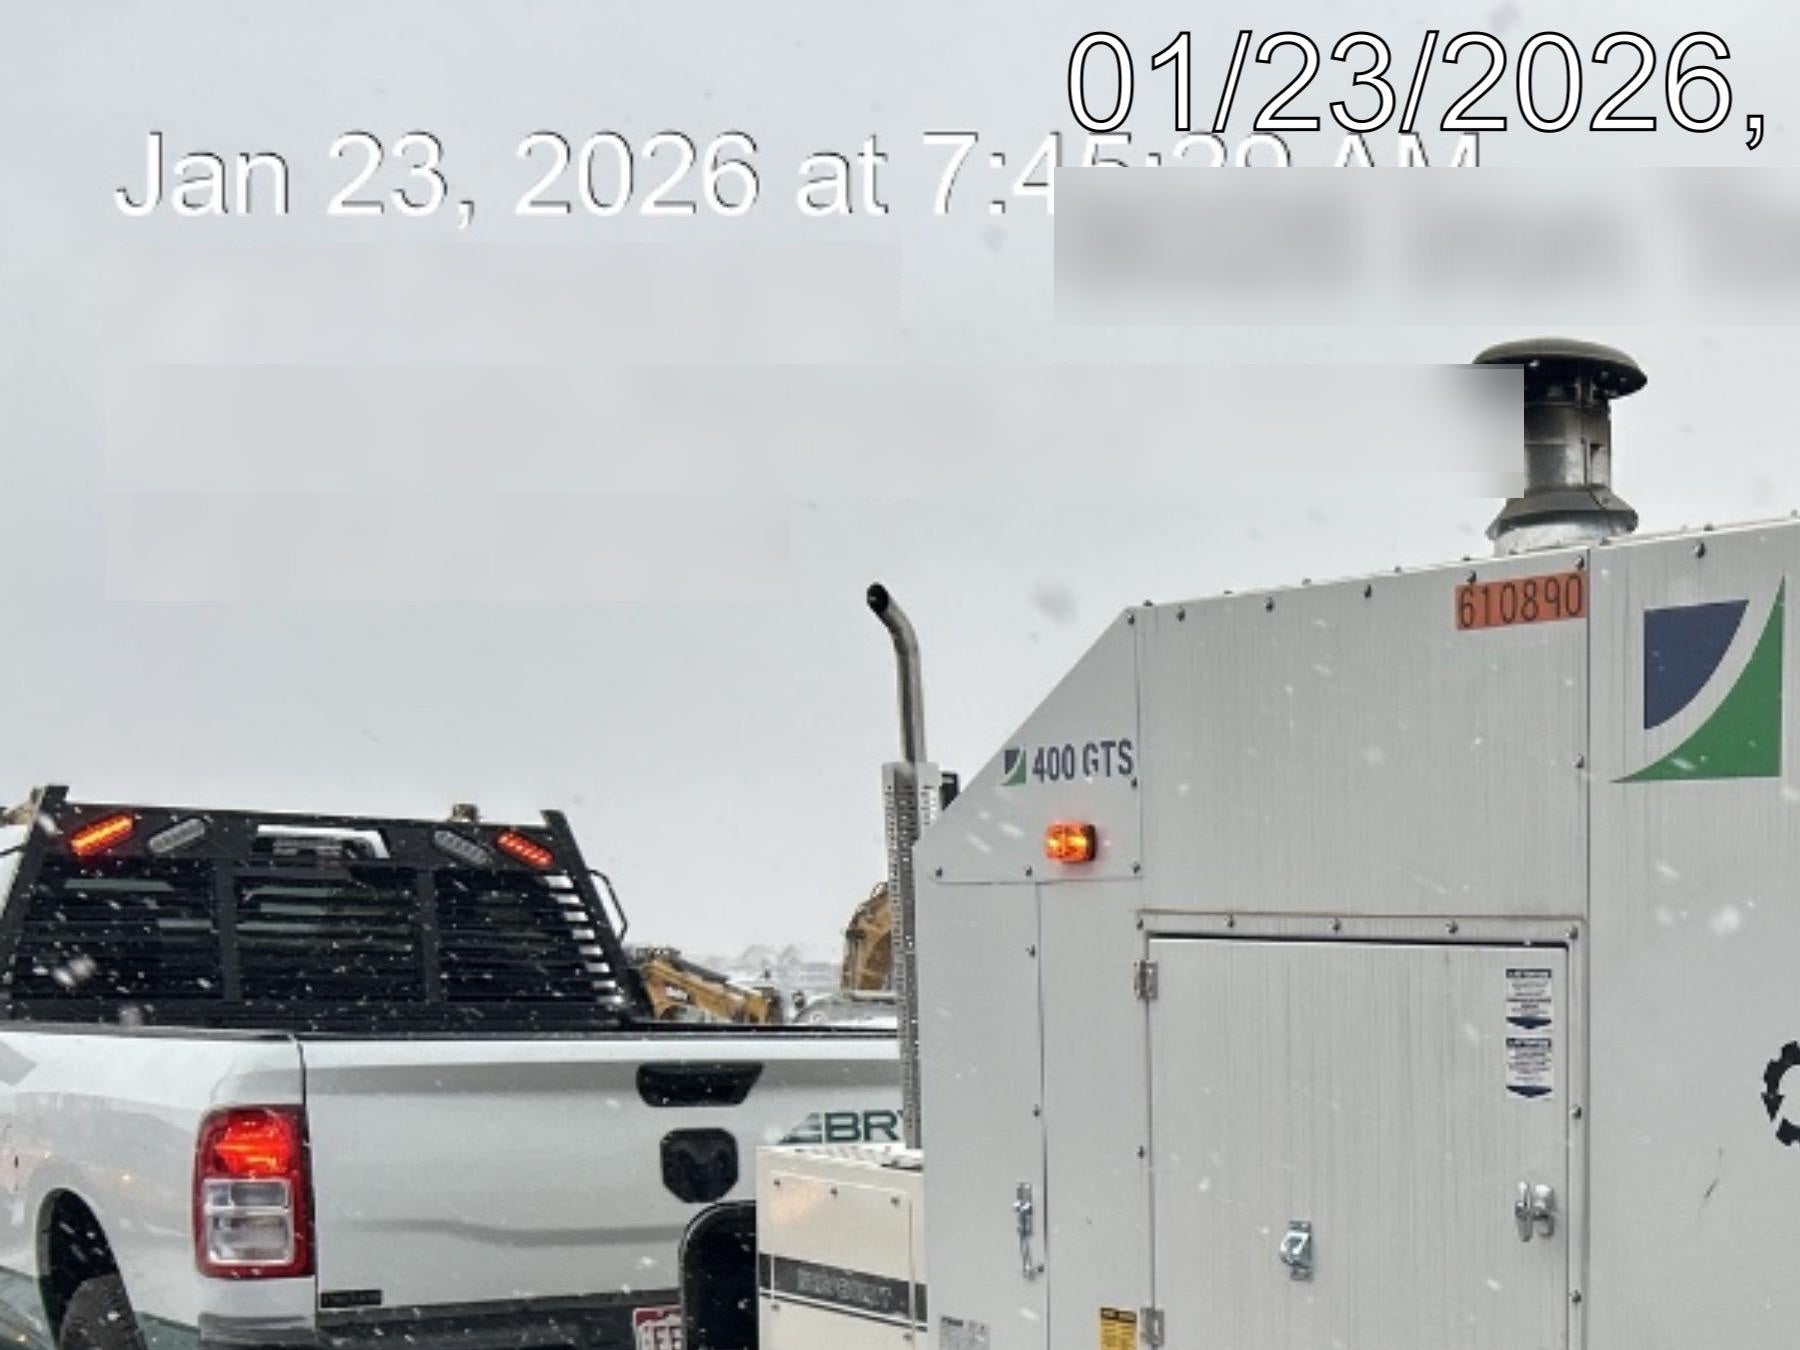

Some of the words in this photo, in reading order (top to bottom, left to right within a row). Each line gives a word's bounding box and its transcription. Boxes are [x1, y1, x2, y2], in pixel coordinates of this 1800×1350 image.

[1461, 574, 1582, 628] 610890
[1032, 743, 1075, 783] 400
[1083, 738, 1134, 778] GTS
